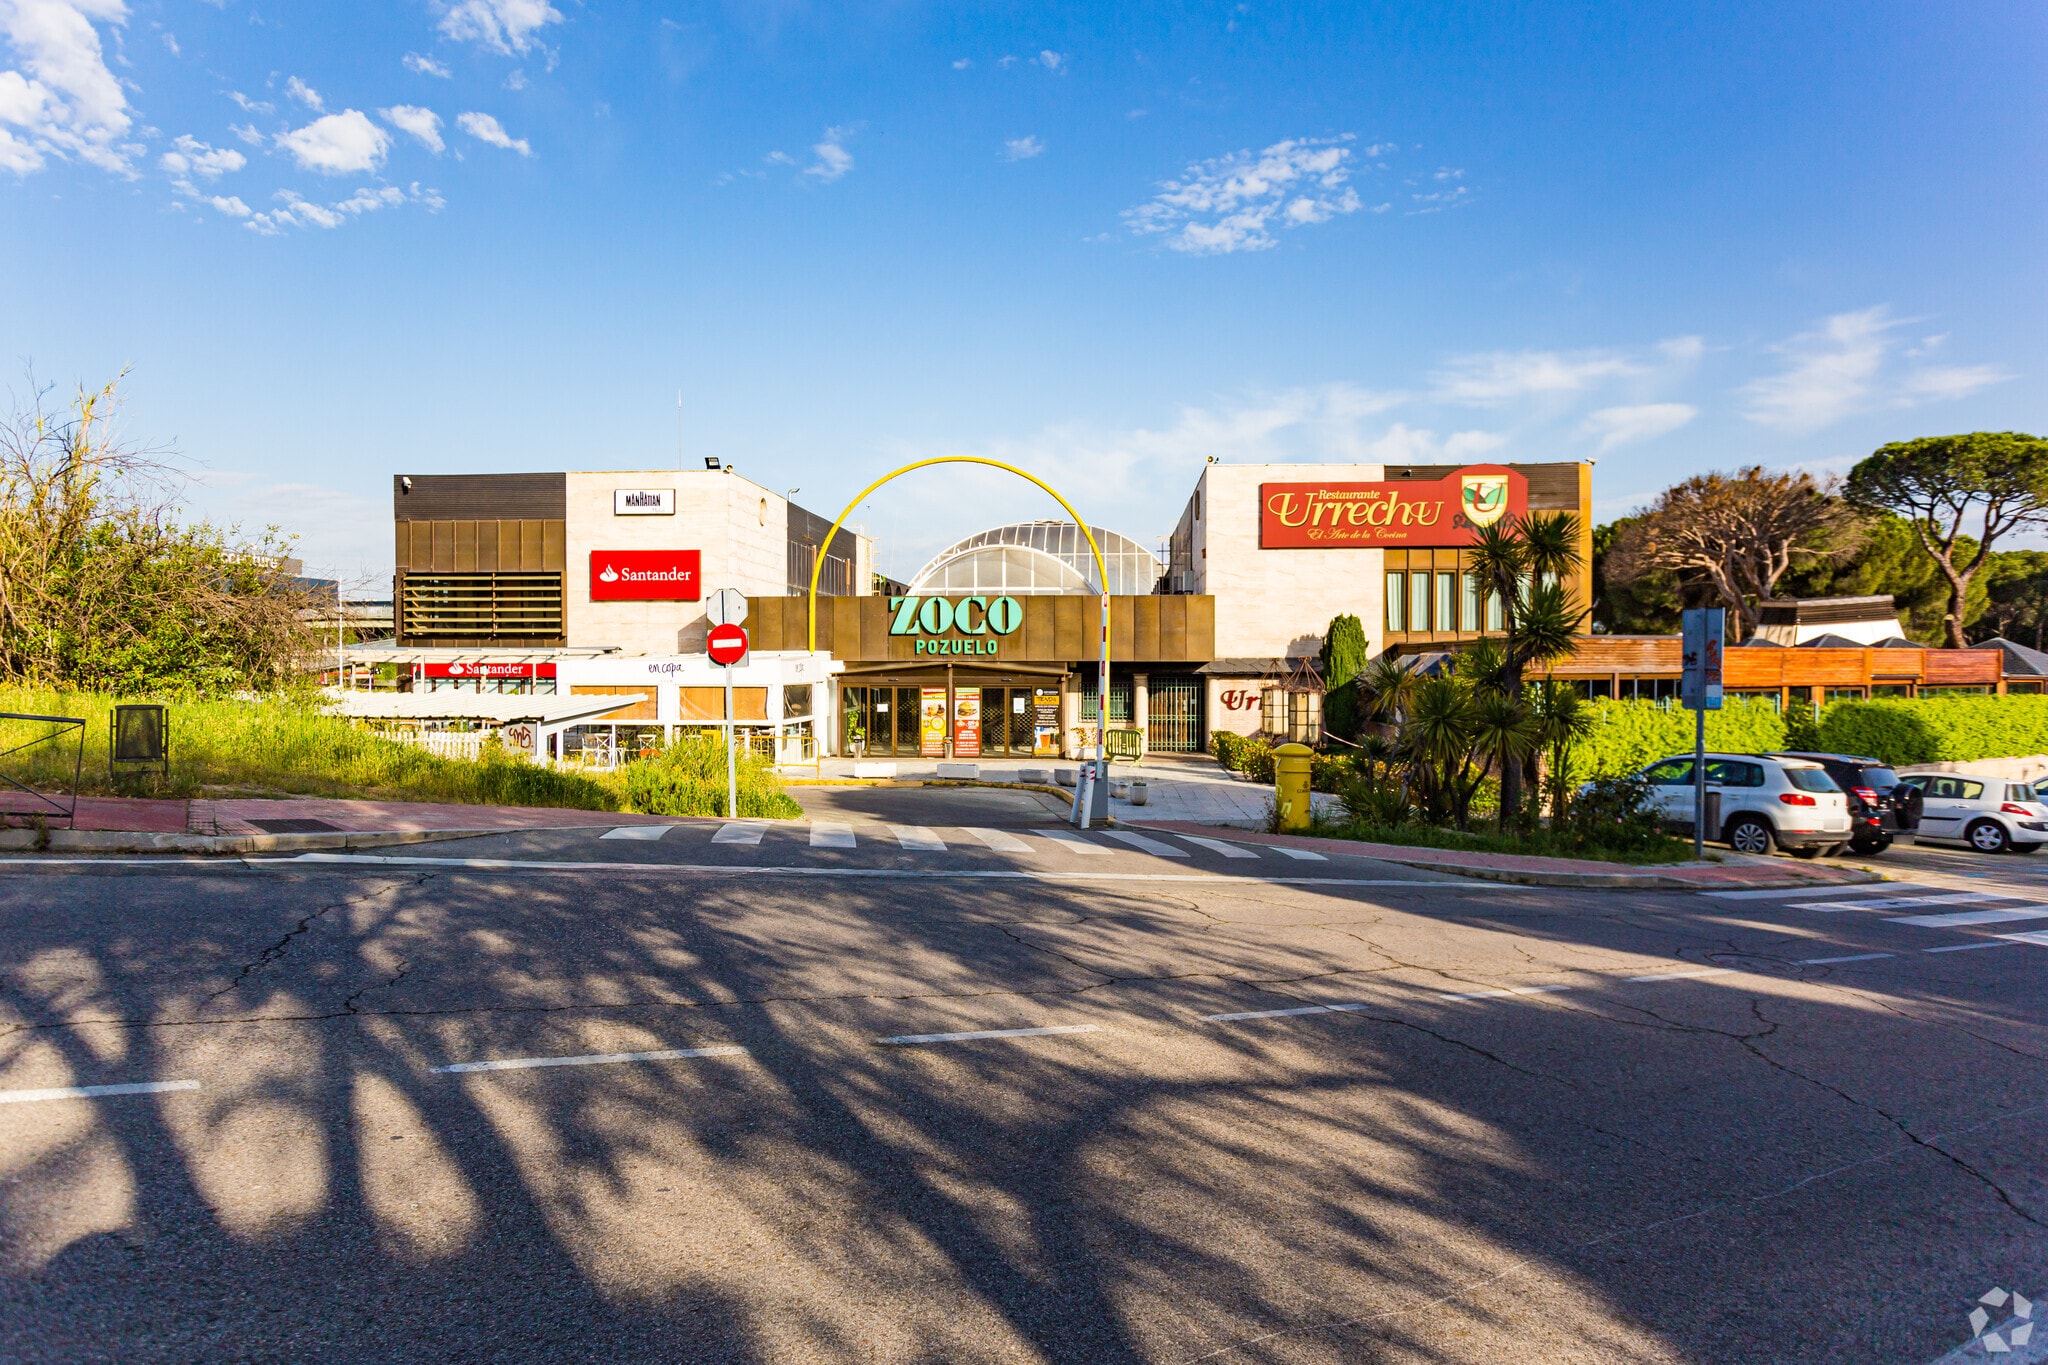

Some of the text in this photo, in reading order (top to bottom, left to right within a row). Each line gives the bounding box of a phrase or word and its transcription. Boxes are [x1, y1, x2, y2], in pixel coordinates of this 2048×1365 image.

[1318, 489, 1381, 500] Restaurante
[1267, 491, 1445, 528] Urrechu
[1324, 527, 1350, 540] Arte
[1349, 530, 1361, 539] de
[1361, 530, 1371, 539] la
[1373, 526, 1408, 540] Cocina
[621, 566, 692, 582] Santander
[890, 596, 1023, 635] ZOCO
[915, 639, 998, 655] POZUELO
[466, 662, 524, 675] Satander
